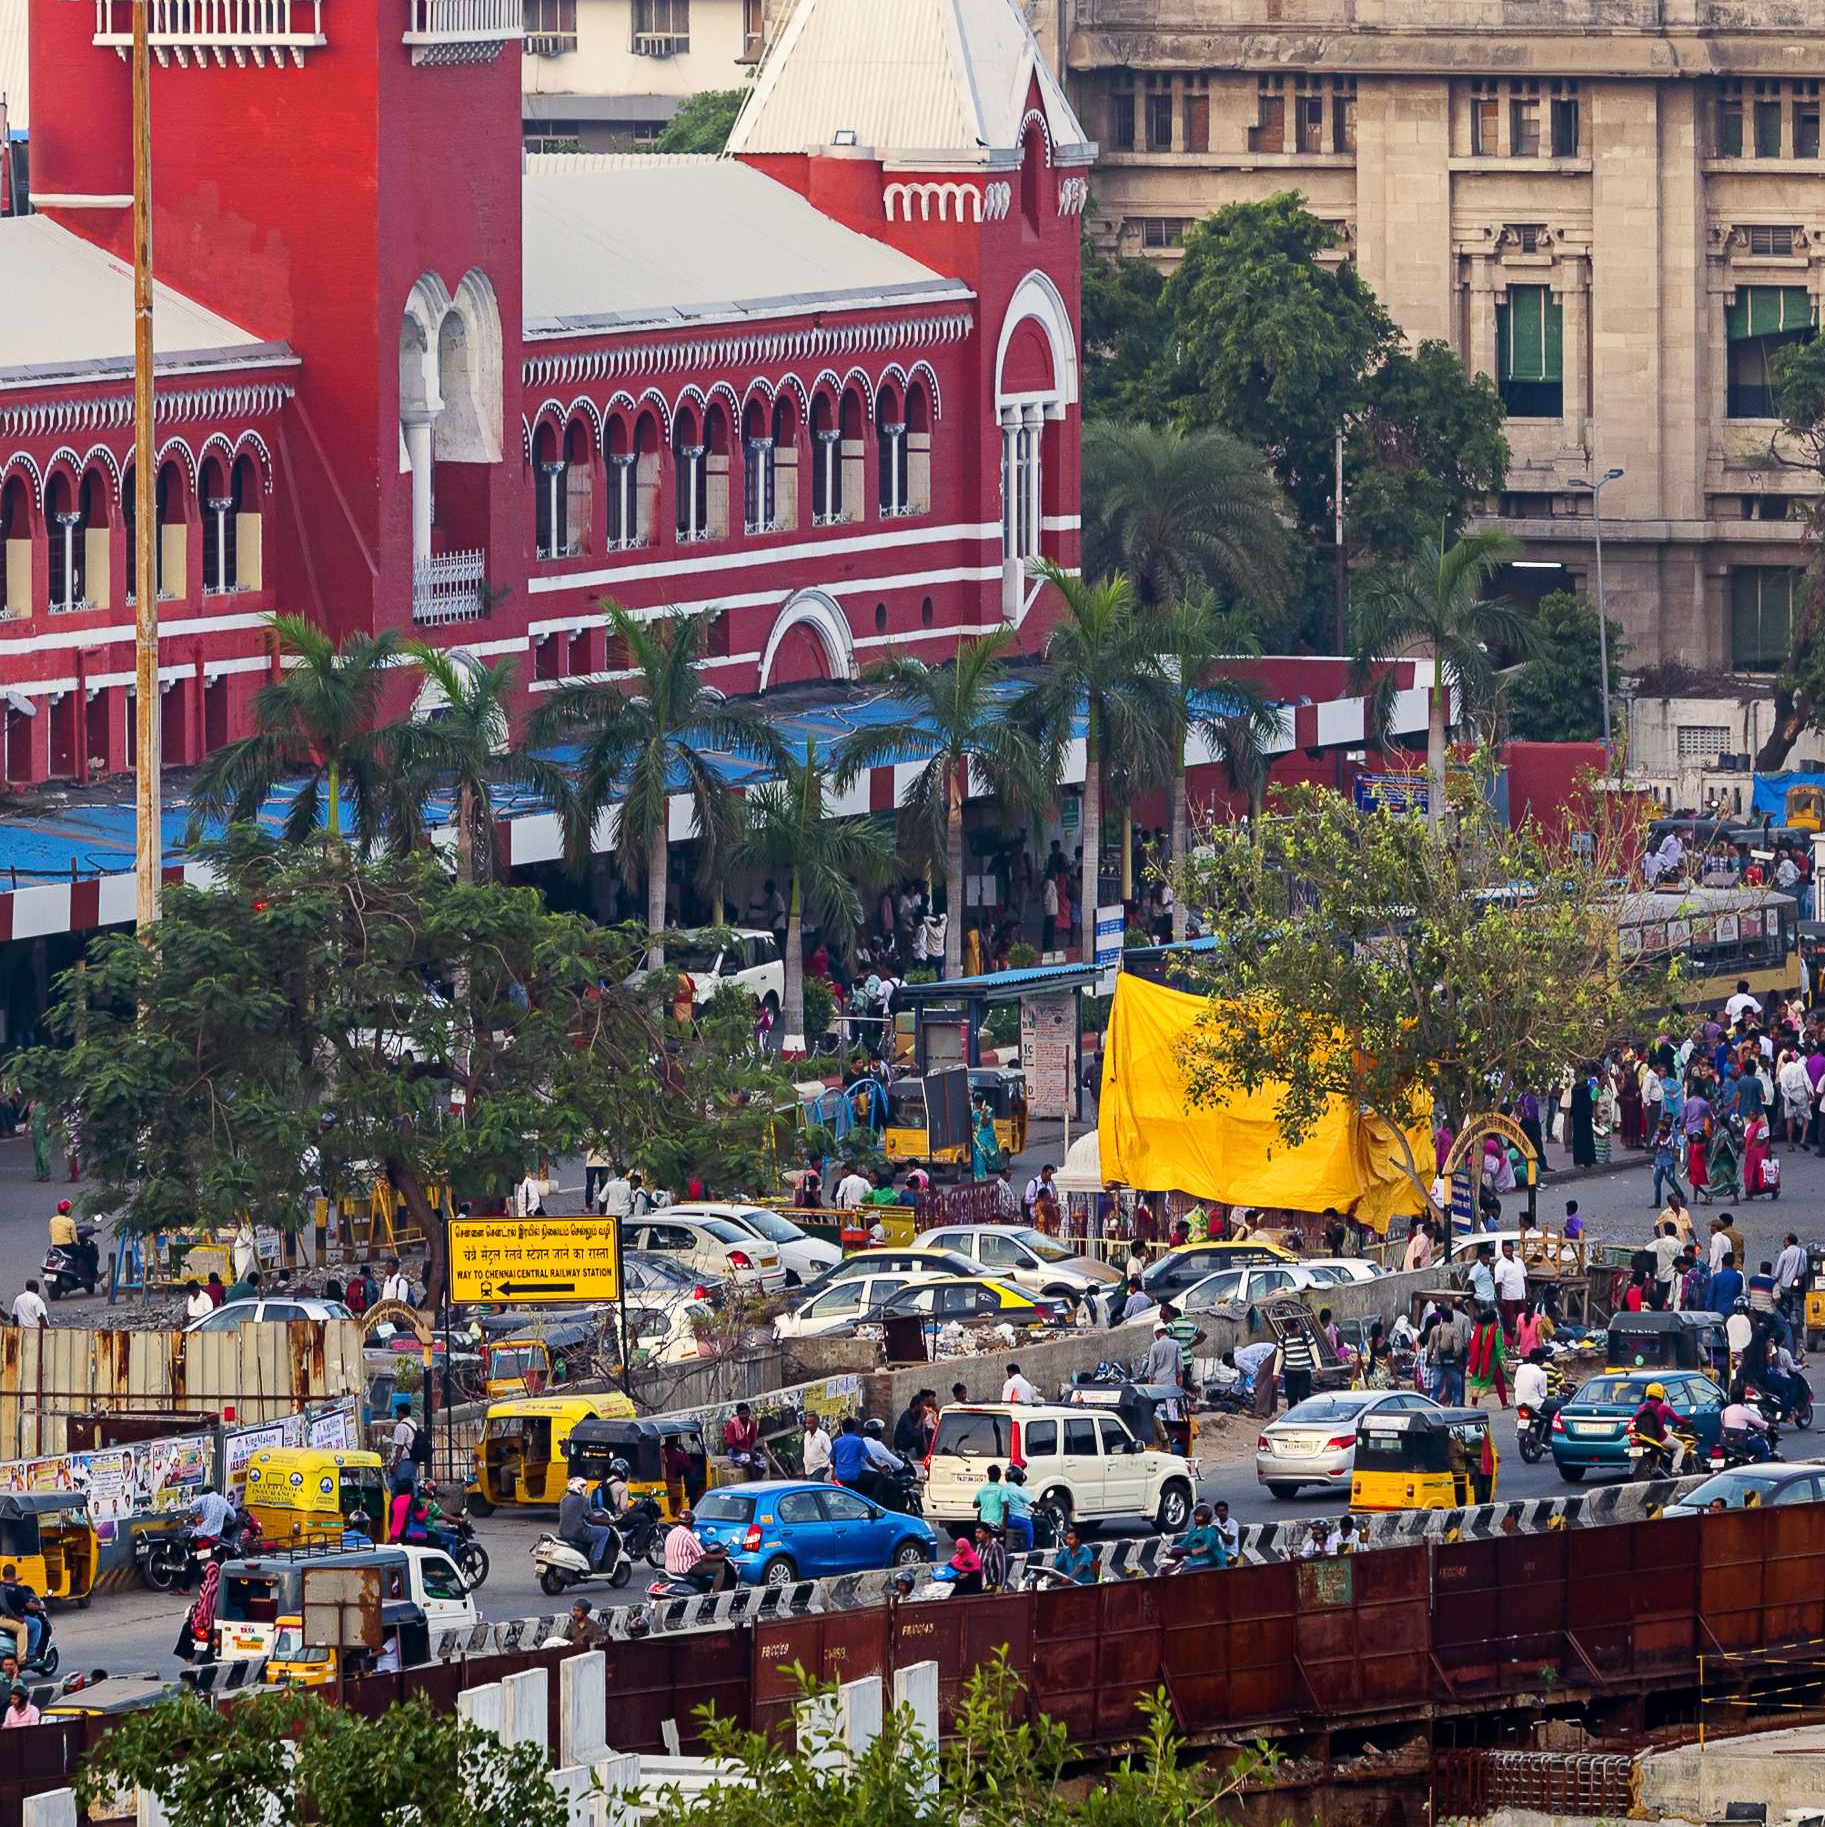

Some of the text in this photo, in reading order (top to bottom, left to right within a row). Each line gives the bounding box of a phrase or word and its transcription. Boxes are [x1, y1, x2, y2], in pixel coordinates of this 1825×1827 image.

[457, 1268, 612, 1280] WAY TO CHENNAI CENTRAL RAILWAY STATION
